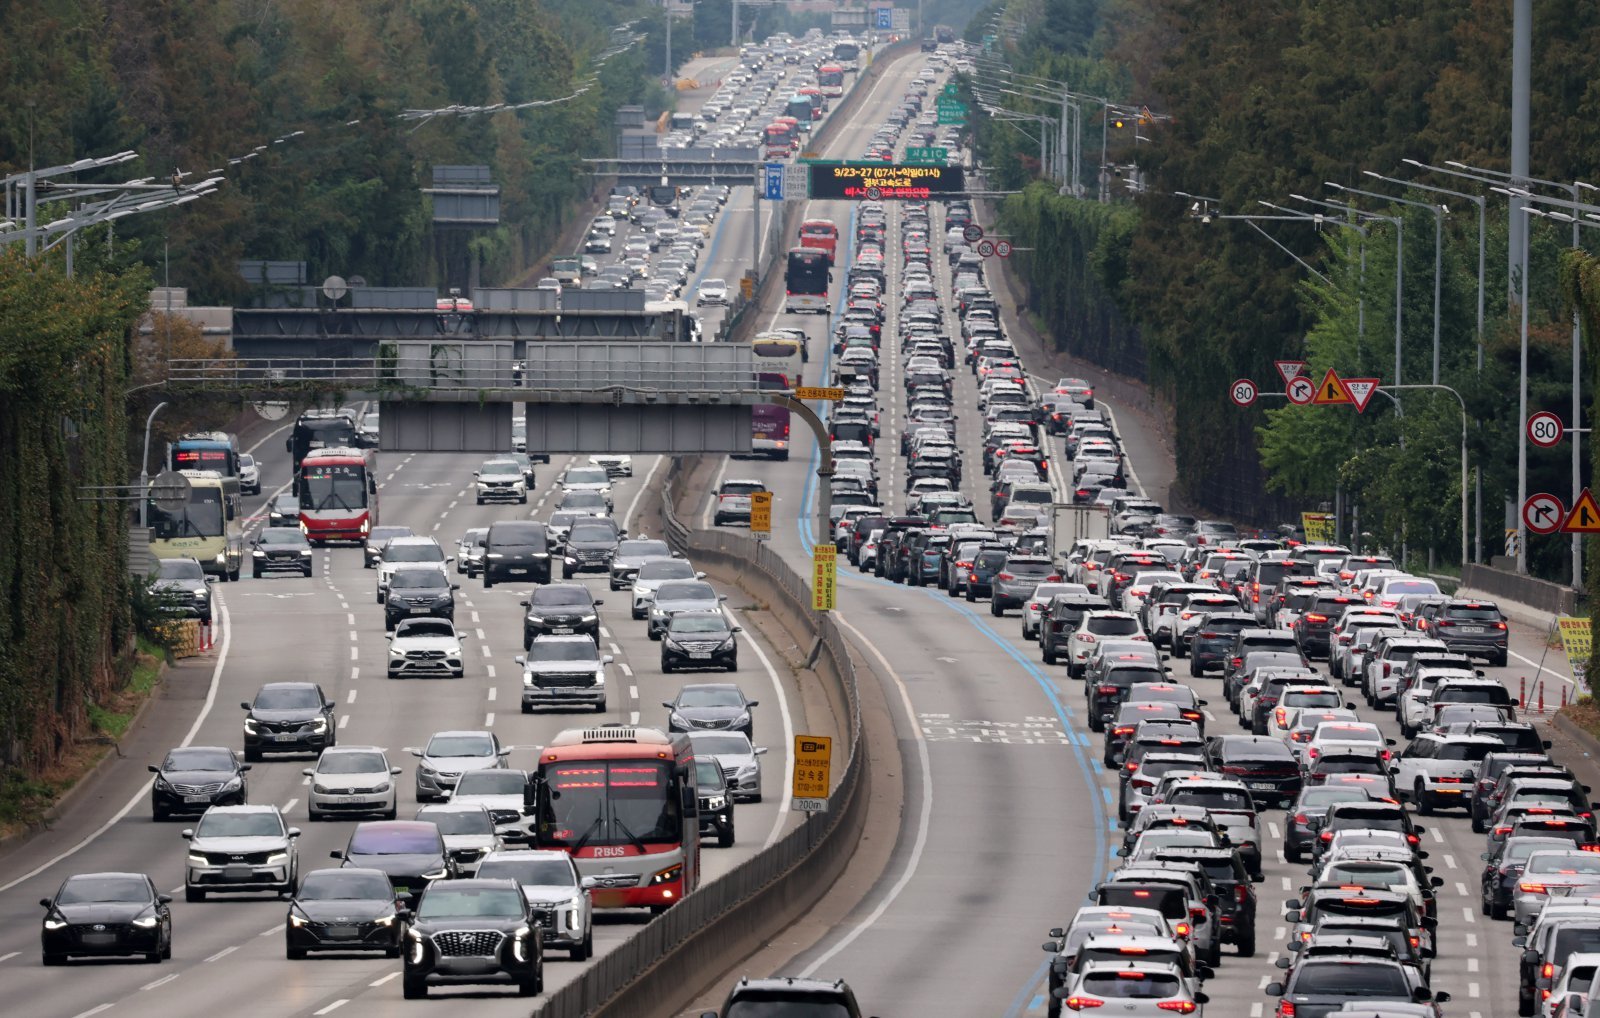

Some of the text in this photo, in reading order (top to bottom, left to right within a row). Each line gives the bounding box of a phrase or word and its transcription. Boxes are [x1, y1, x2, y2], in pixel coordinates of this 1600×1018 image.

[1236, 386, 1252, 400] 80
[1535, 421, 1556, 439] 80
[798, 769, 824, 782] 단속중
[799, 800, 822, 810] 200m
